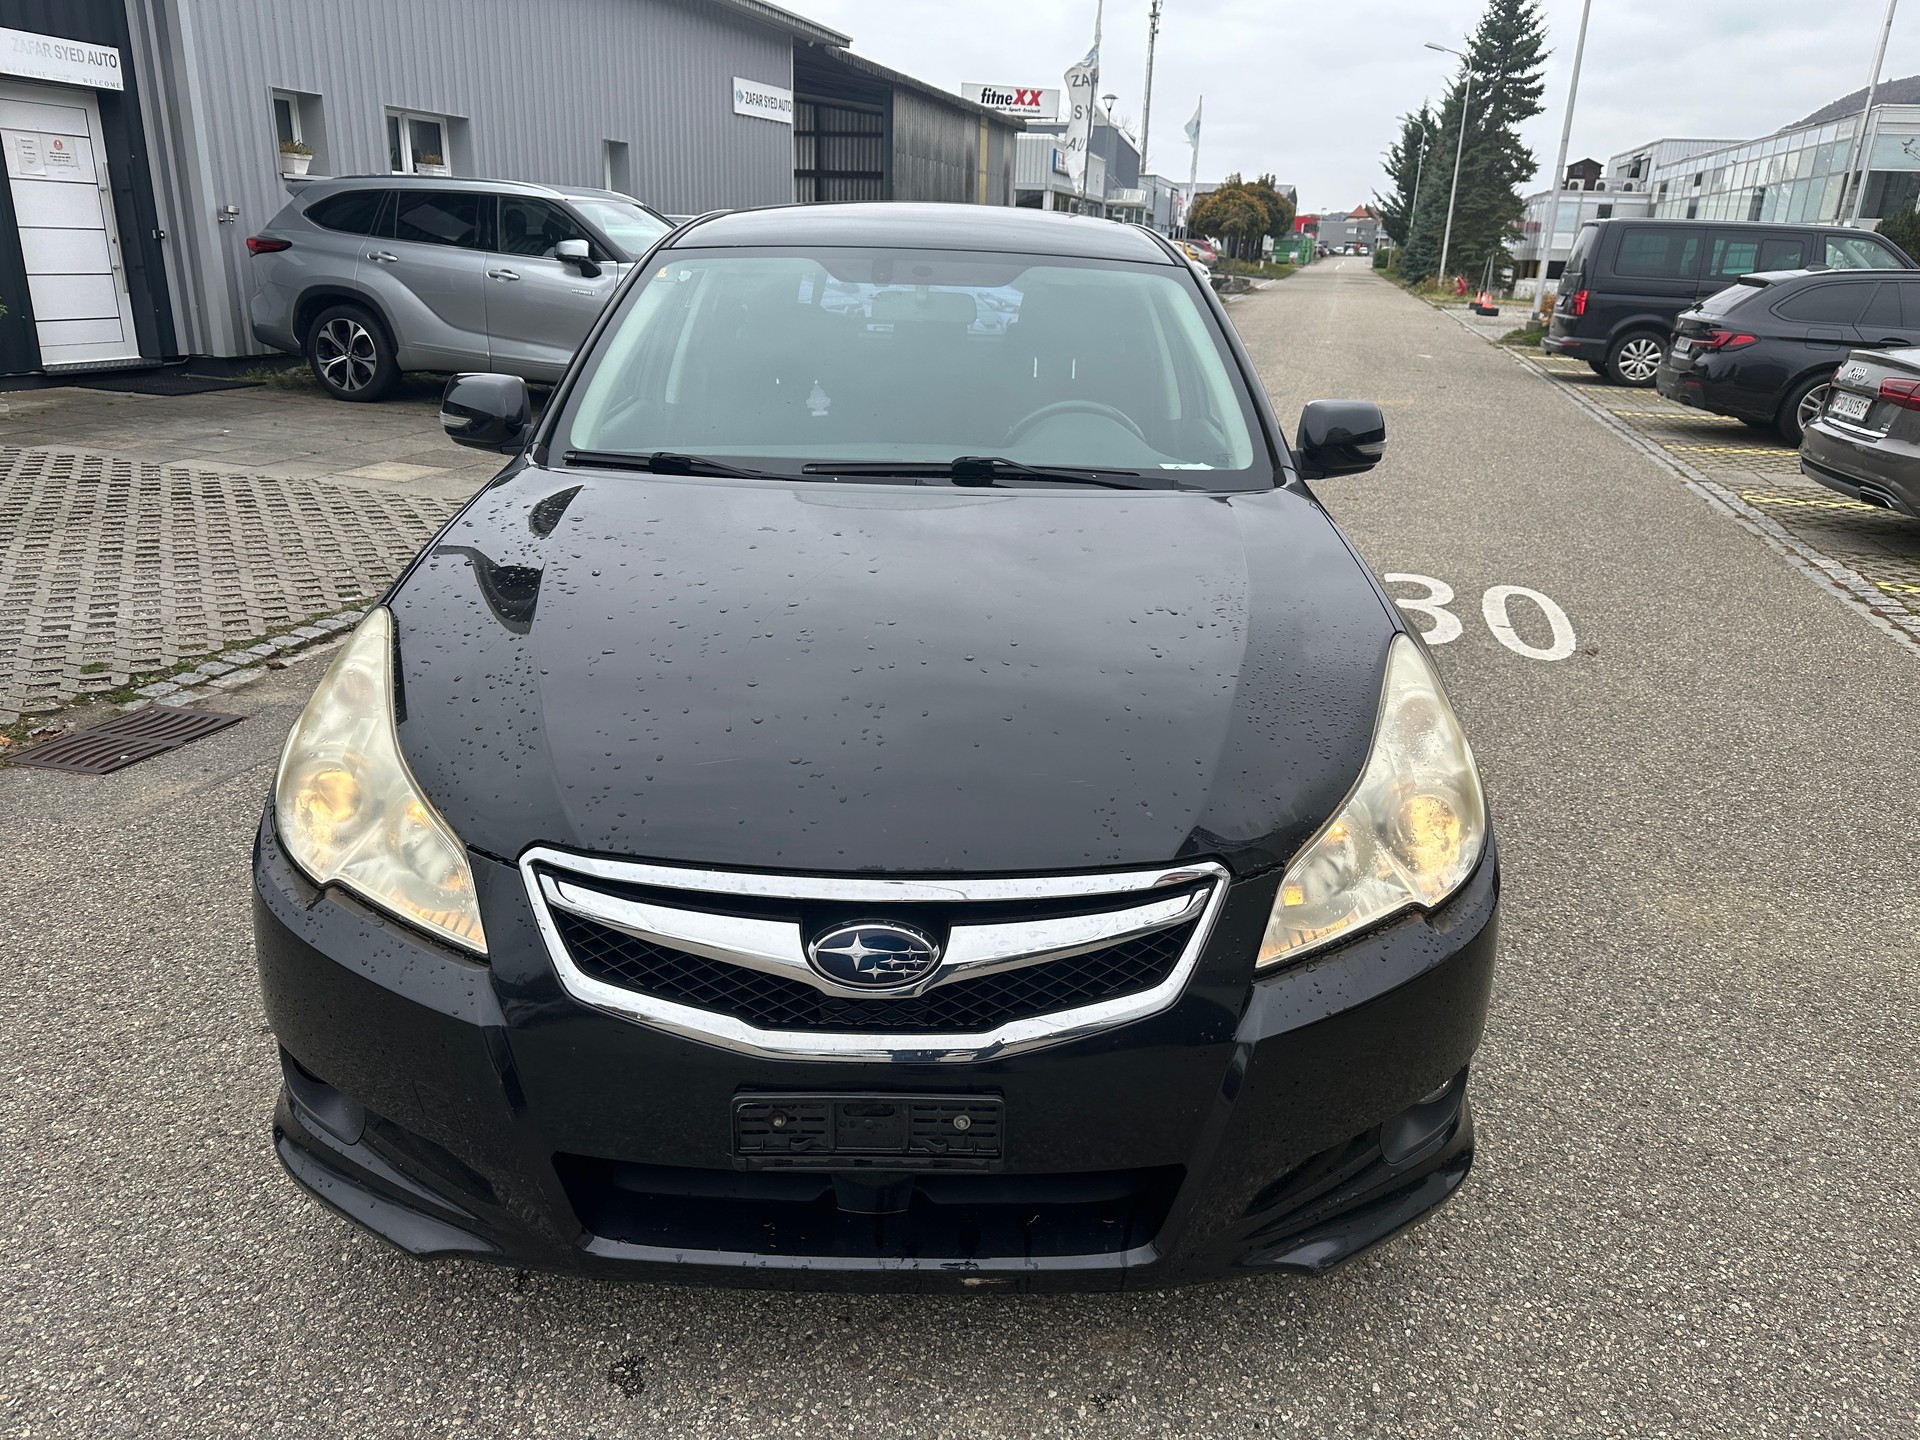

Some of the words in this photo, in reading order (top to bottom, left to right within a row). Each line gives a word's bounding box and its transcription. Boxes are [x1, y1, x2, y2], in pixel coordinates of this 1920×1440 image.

[11, 37, 53, 58] ZAFAR
[54, 44, 85, 63] SYED
[88, 50, 118, 68] AUTO
[82, 77, 121, 89] WELCOME
[745, 91, 763, 108] ZAFAR
[764, 95, 778, 110] SYED
[778, 98, 792, 113] AUTO
[981, 87, 1043, 107] fitneXX
[1384, 572, 1576, 661] 30
